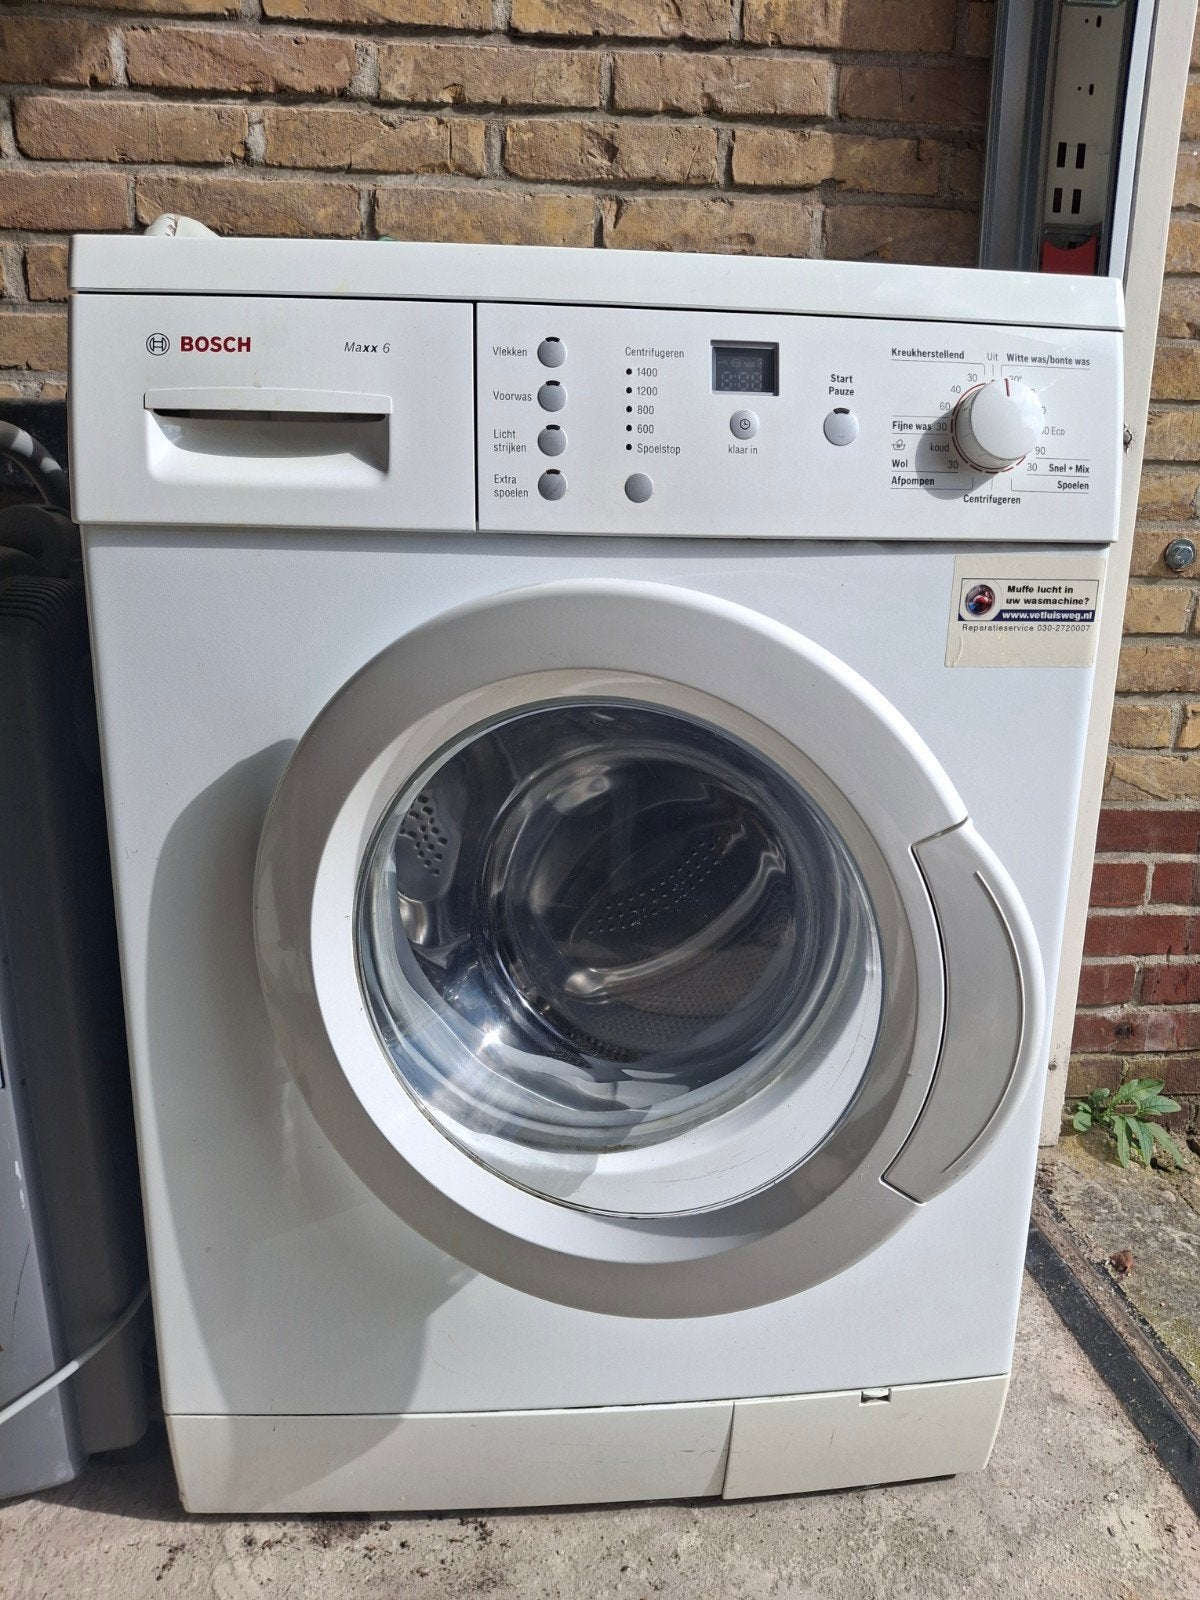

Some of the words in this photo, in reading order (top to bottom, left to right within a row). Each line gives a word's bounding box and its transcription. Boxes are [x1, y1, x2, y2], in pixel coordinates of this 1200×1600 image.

[180, 336, 251, 352] BOSCH
[344, 341, 377, 353] Maxx
[383, 343, 390, 354] 6
[493, 347, 528, 357] Vlekken
[625, 347, 684, 359] Centrifugeren
[891, 349, 964, 360] Kreukherstellend
[987, 352, 998, 361] Uit
[1007, 353, 1028, 363] Witte
[1031, 354, 1074, 365] was/bonte
[1076, 357, 1090, 366] was
[636, 367, 657, 377] 1400
[831, 374, 853, 384] Start
[968, 374, 978, 382] 30
[637, 386, 657, 396] 1200
[829, 387, 854, 396] Pauze
[951, 385, 961, 394] 40
[493, 391, 532, 402] Voorwas
[637, 405, 654, 415] 800
[940, 402, 950, 411] 60
[637, 424, 654, 434] 600
[892, 421, 913, 431] Fijne
[915, 422, 932, 431] was
[937, 422, 947, 431] 30
[1052, 427, 1065, 435] Eco
[494, 430, 516, 439] Licht
[494, 443, 526, 454] strijken
[637, 444, 681, 455] Spoelstop
[728, 445, 747, 455] klaar
[750, 445, 757, 455] in
[930, 443, 949, 452] koud
[1035, 447, 1046, 455] 90
[892, 460, 908, 468] Wol
[948, 460, 958, 469] 30
[1027, 463, 1037, 471] 30
[1049, 464, 1066, 472] Snel
[1075, 465, 1089, 474] Mix
[494, 475, 517, 484] Extra
[891, 476, 935, 487] Afpompen
[1057, 481, 1089, 491] Spoelen
[494, 488, 528, 498] spoelen
[964, 494, 1021, 506] Centrifugeren
[1008, 585, 1034, 593] Muffe
[1065, 586, 1073, 594] in
[1002, 612, 1092, 621] www.vetluisweg.nl
[962, 624, 1034, 632] Reparatieservice
